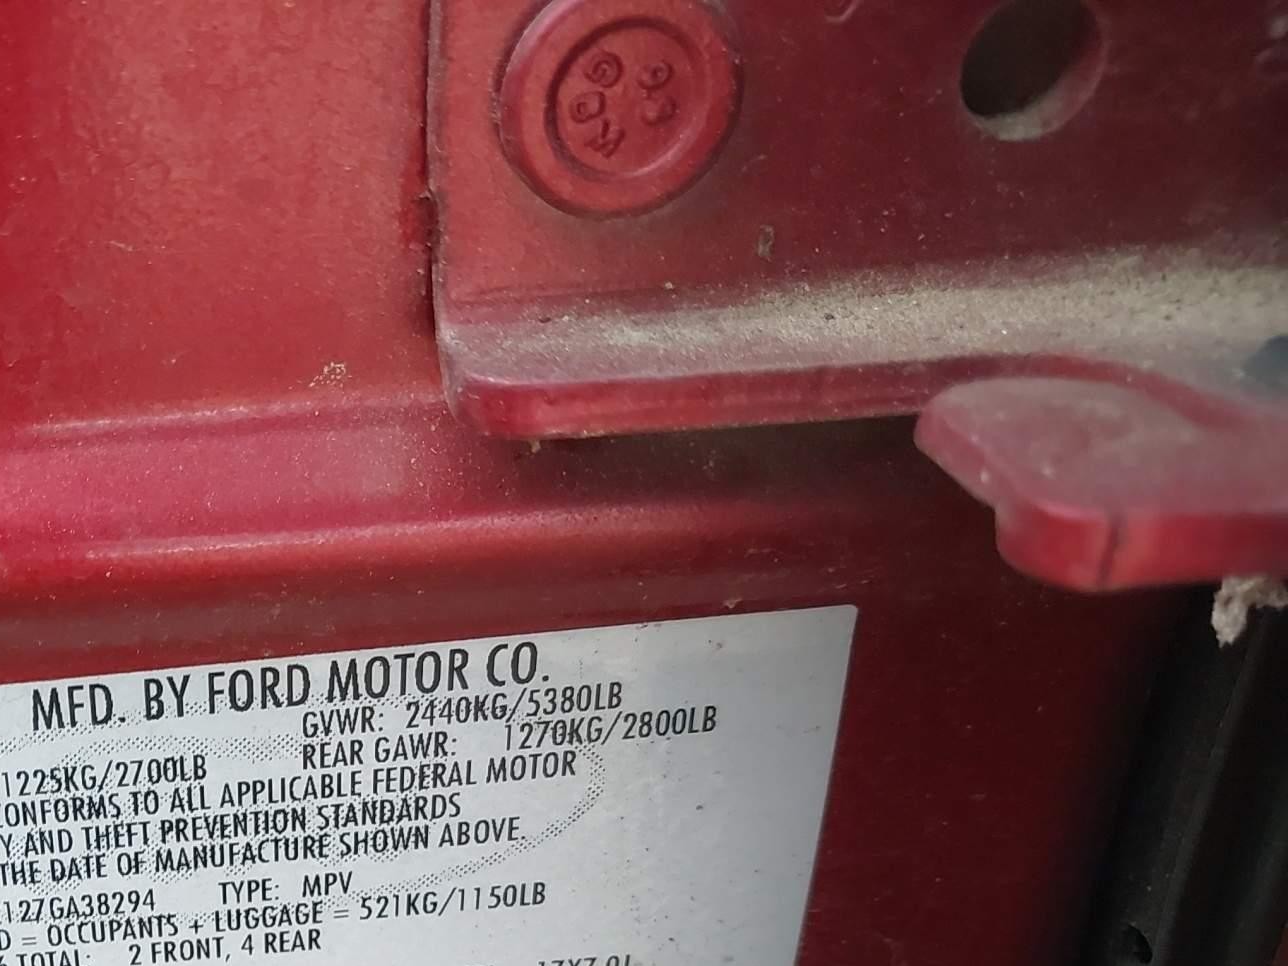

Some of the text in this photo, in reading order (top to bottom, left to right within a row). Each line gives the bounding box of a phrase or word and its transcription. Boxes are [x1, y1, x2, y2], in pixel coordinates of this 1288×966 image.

[32, 642, 550, 731] MFD. BY FORD MOTOR CO.
[302, 681, 624, 738] GVWR: 2440KG/5380LB
[302, 705, 718, 771] REAR GAWR: 1270KG/2800LB
[0, 754, 208, 798] 1225KG/2700LB
[131, 788, 160, 816] TO
[169, 783, 212, 813] ALL
[220, 768, 362, 807] APPLICABLE
[372, 758, 478, 795] FEDERAL
[486, 749, 577, 783] MOTOR
[22, 825, 73, 857] AND
[82, 819, 151, 851] THEFT
[160, 806, 307, 844] PREVENTION
[317, 792, 462, 829] STANDARDS
[50, 850, 108, 882] DATE
[118, 847, 147, 875] OF
[154, 832, 331, 874] MANUFACTURE
[339, 824, 431, 857] SHOWN
[47, 913, 179, 947] OCCUPANTS
[214, 900, 323, 933] LUGGAGE
[359, 882, 546, 921] 521KG/1150LB
[218, 875, 280, 905] TYPE:
[302, 871, 353, 897] MPV
[128, 944, 142, 966] 2
[150, 936, 230, 964] FRONT,
[241, 934, 255, 956] 4
[263, 929, 322, 954] REAR
